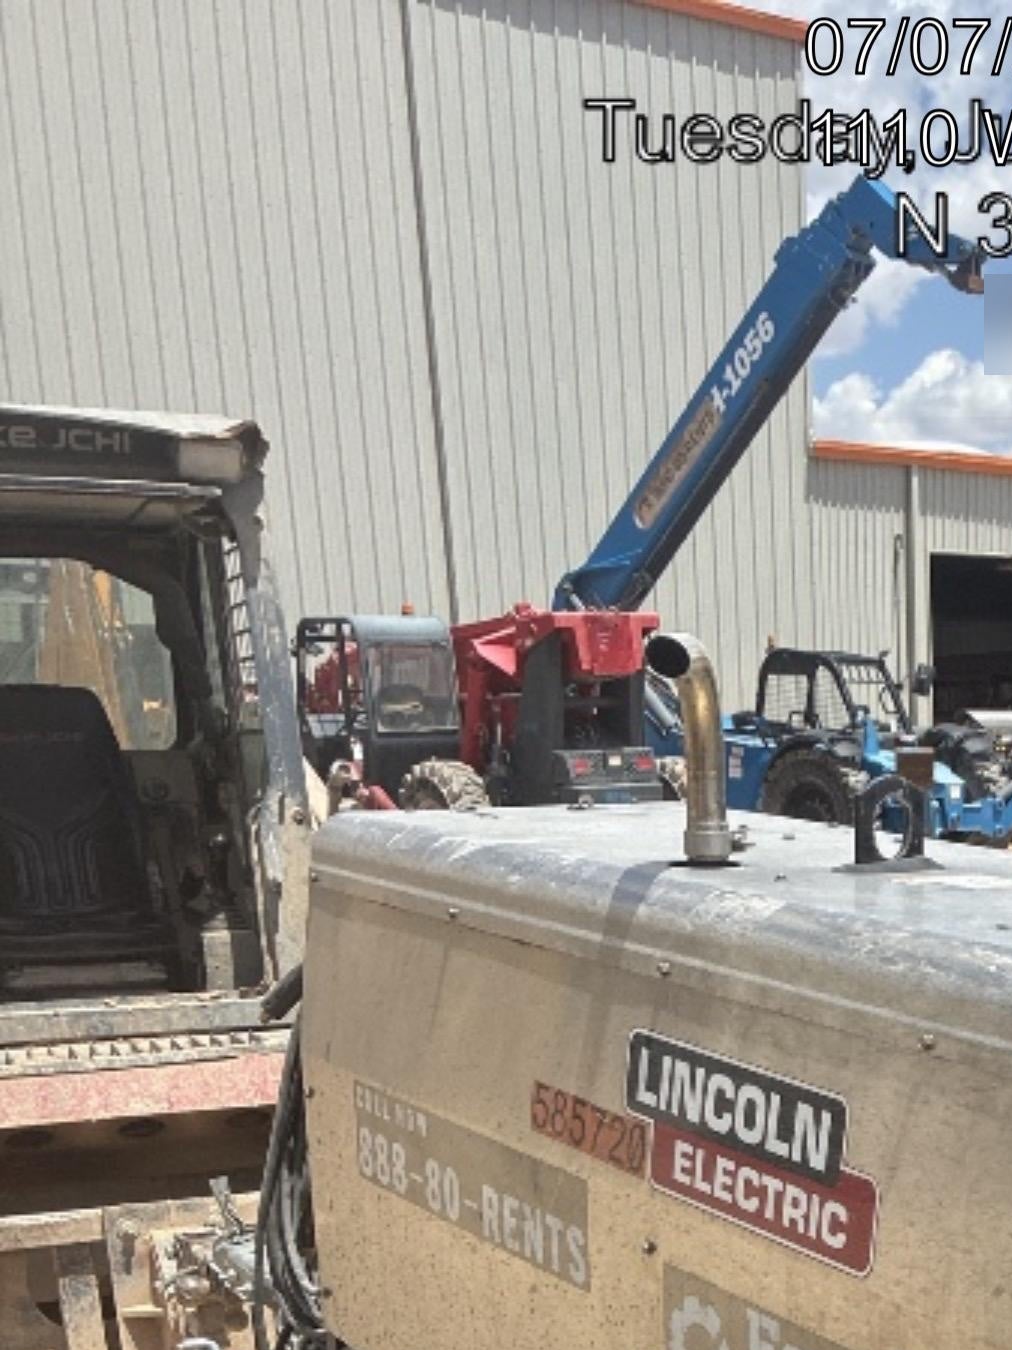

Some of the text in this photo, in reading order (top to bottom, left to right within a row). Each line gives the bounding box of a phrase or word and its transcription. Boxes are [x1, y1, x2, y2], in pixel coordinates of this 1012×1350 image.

[532, 1081, 647, 1174] 585720
[635, 1045, 832, 1172] LINCOLN
[358, 1125, 587, 1286] 888-80-RENTS
[672, 1138, 849, 1250] ELECTRIC
